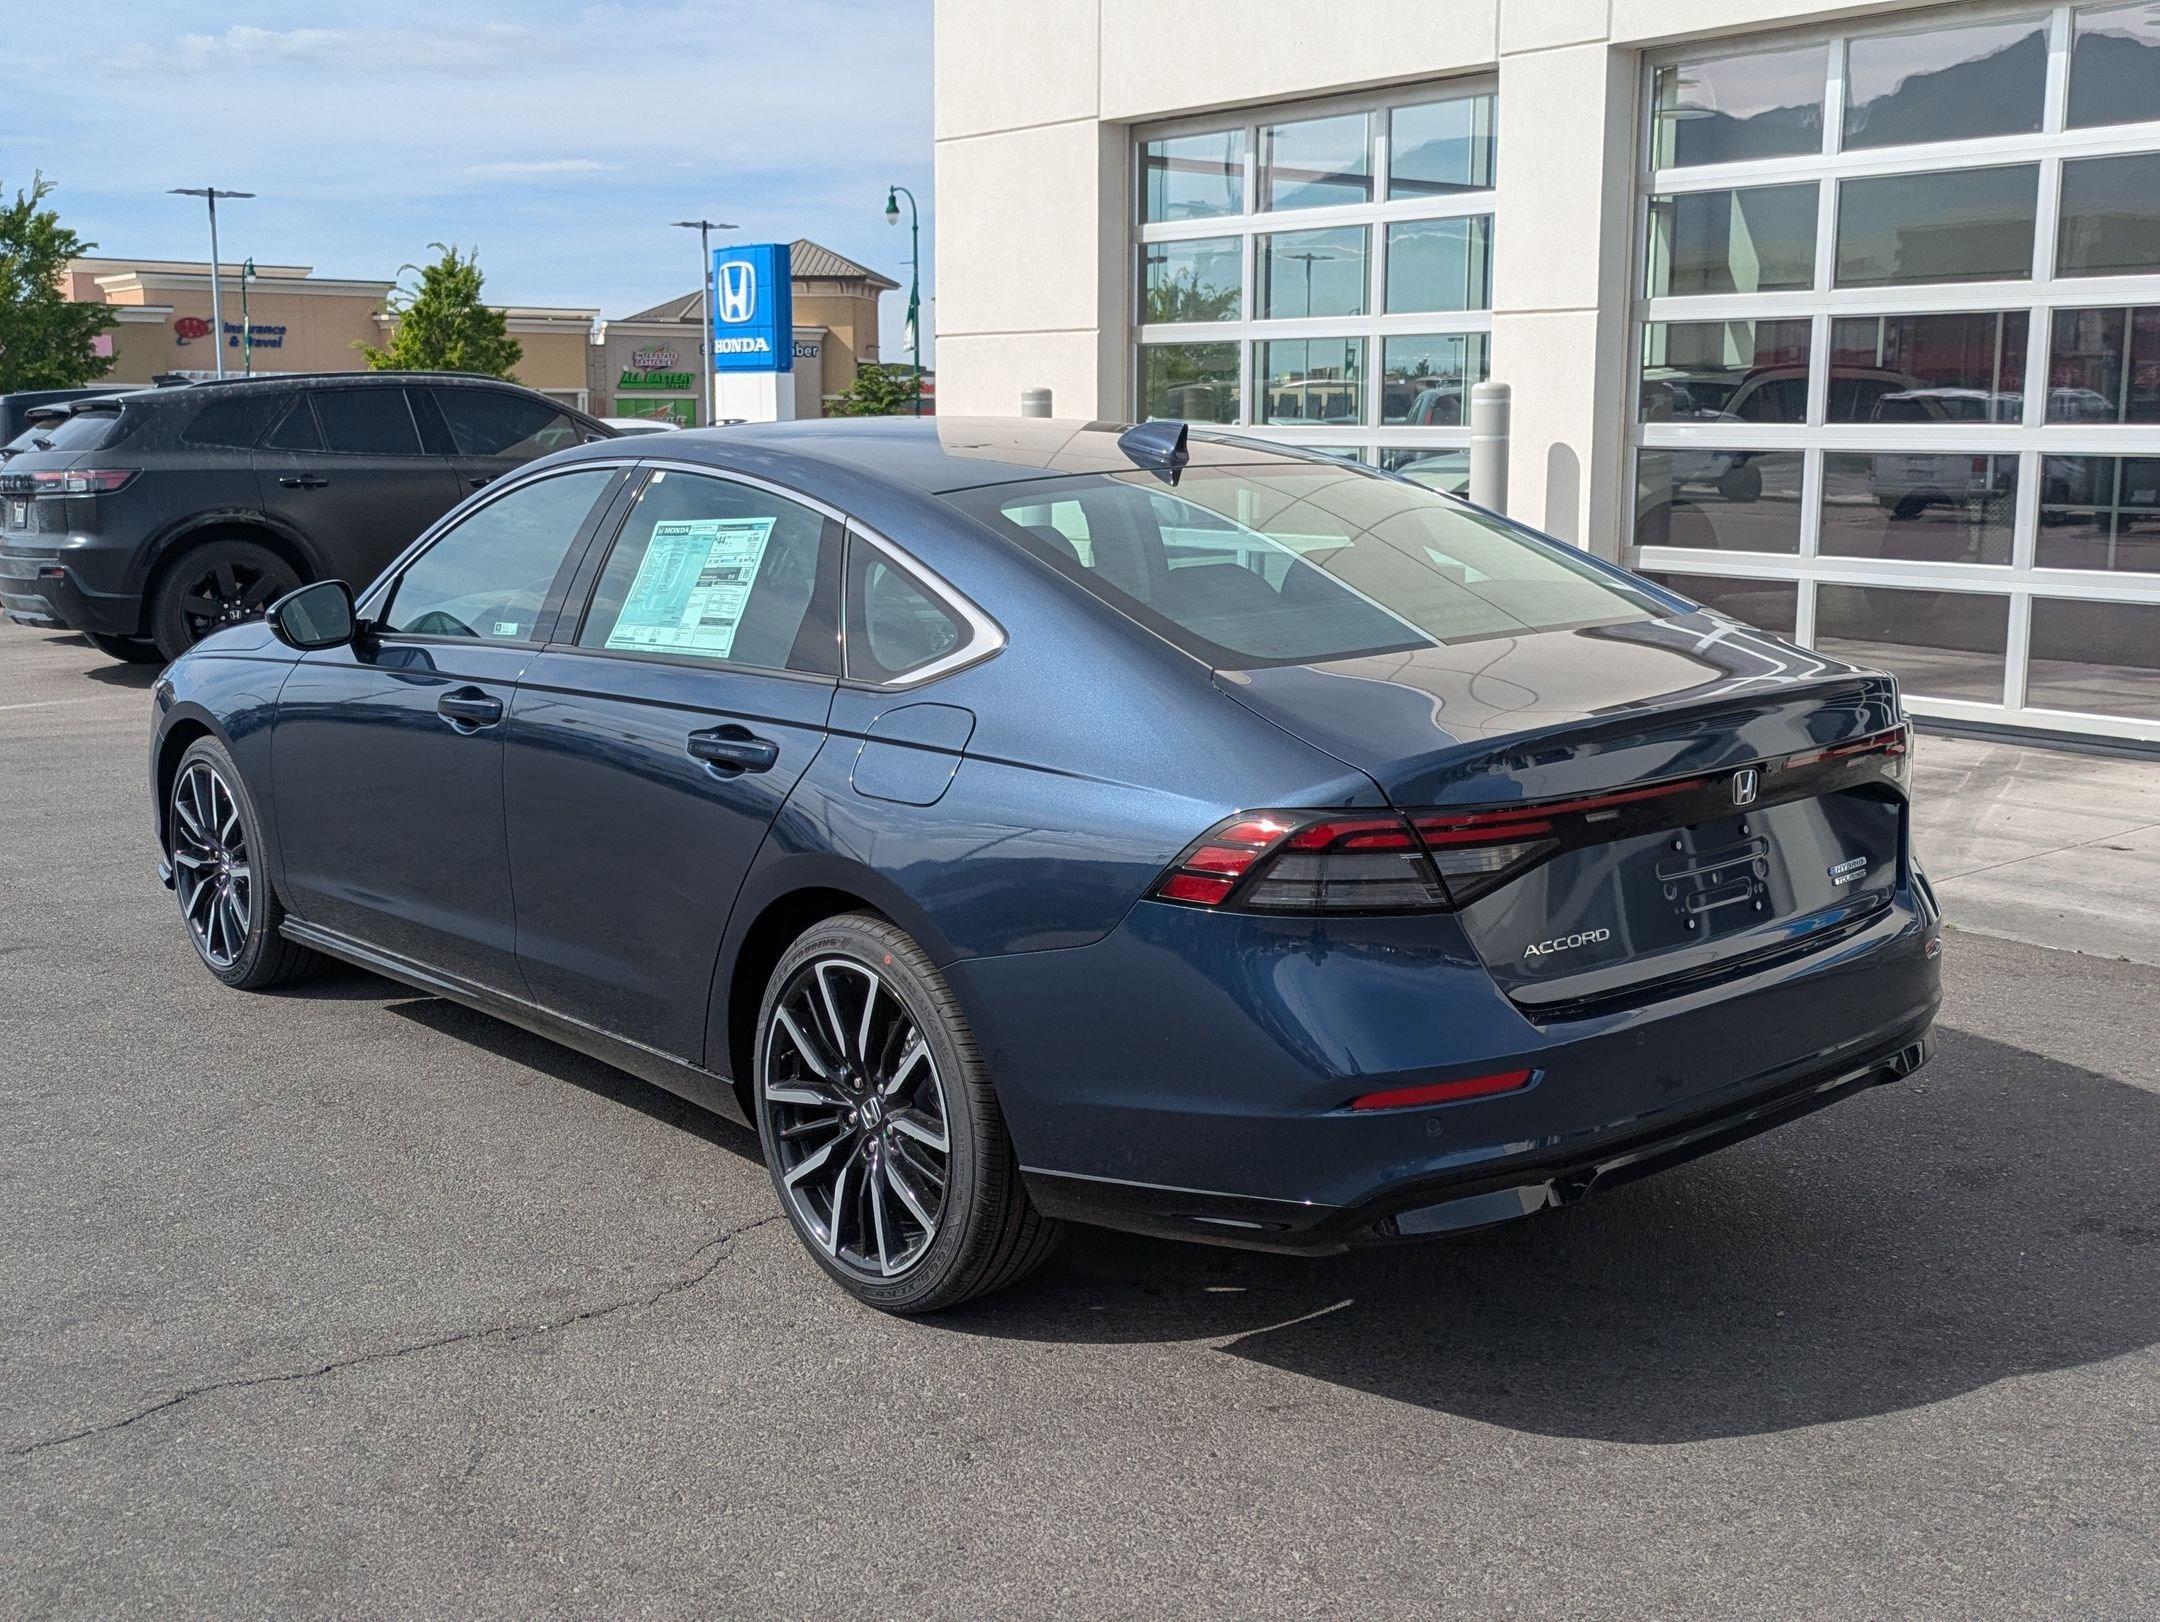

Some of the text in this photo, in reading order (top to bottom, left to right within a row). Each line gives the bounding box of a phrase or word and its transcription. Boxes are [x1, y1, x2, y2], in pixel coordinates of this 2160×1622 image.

[224, 322, 287, 335] Insrance
[229, 336, 239, 347] &
[714, 337, 769, 353] HONDA
[621, 371, 695, 385] ALL BATTERY
[1836, 858, 1864, 873] HYBRID
[1523, 928, 1611, 959] ACCORD
